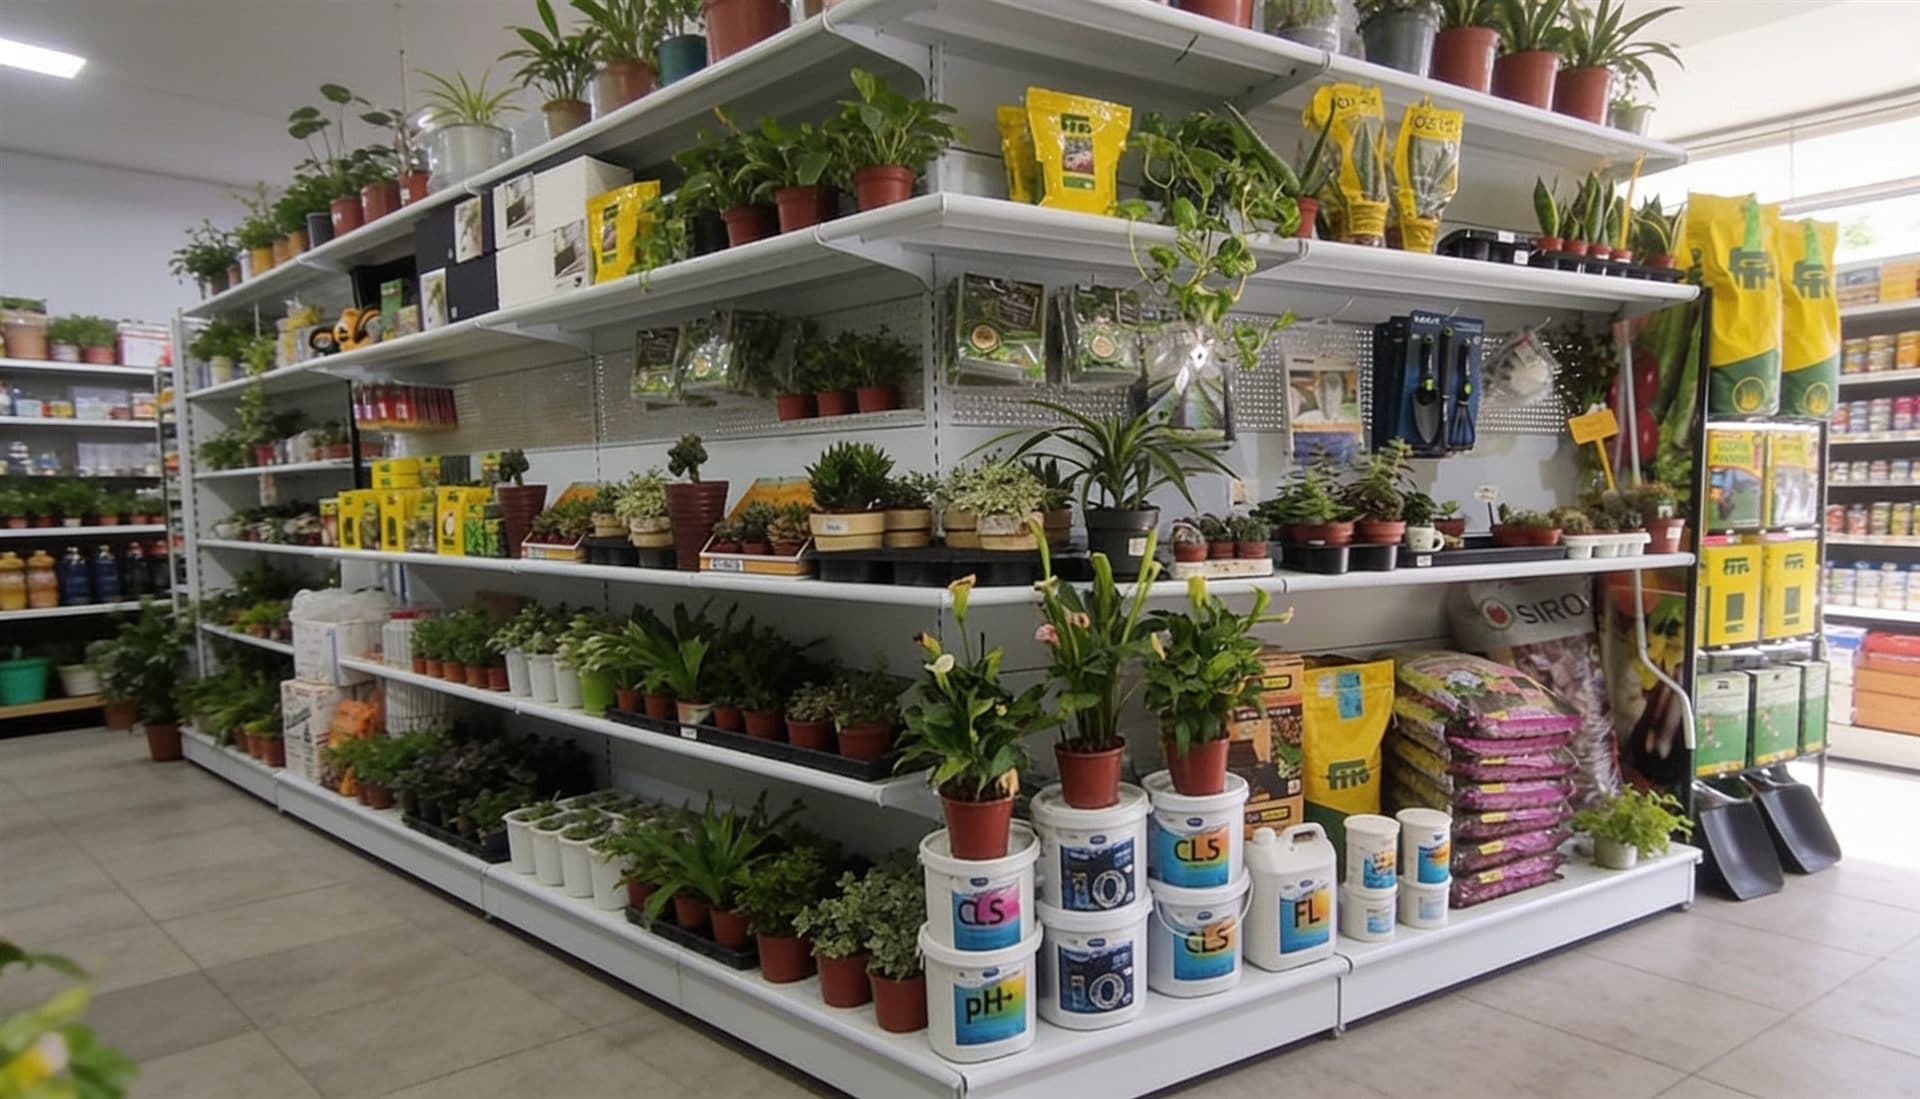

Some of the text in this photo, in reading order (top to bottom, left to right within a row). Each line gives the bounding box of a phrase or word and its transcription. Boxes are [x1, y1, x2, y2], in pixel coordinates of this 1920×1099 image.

[1516, 593, 1585, 625] SIRO
[1173, 838, 1221, 862] CLS
[957, 898, 1005, 926] CLS
[1294, 898, 1321, 928] FL
[1183, 928, 1229, 953] CLS
